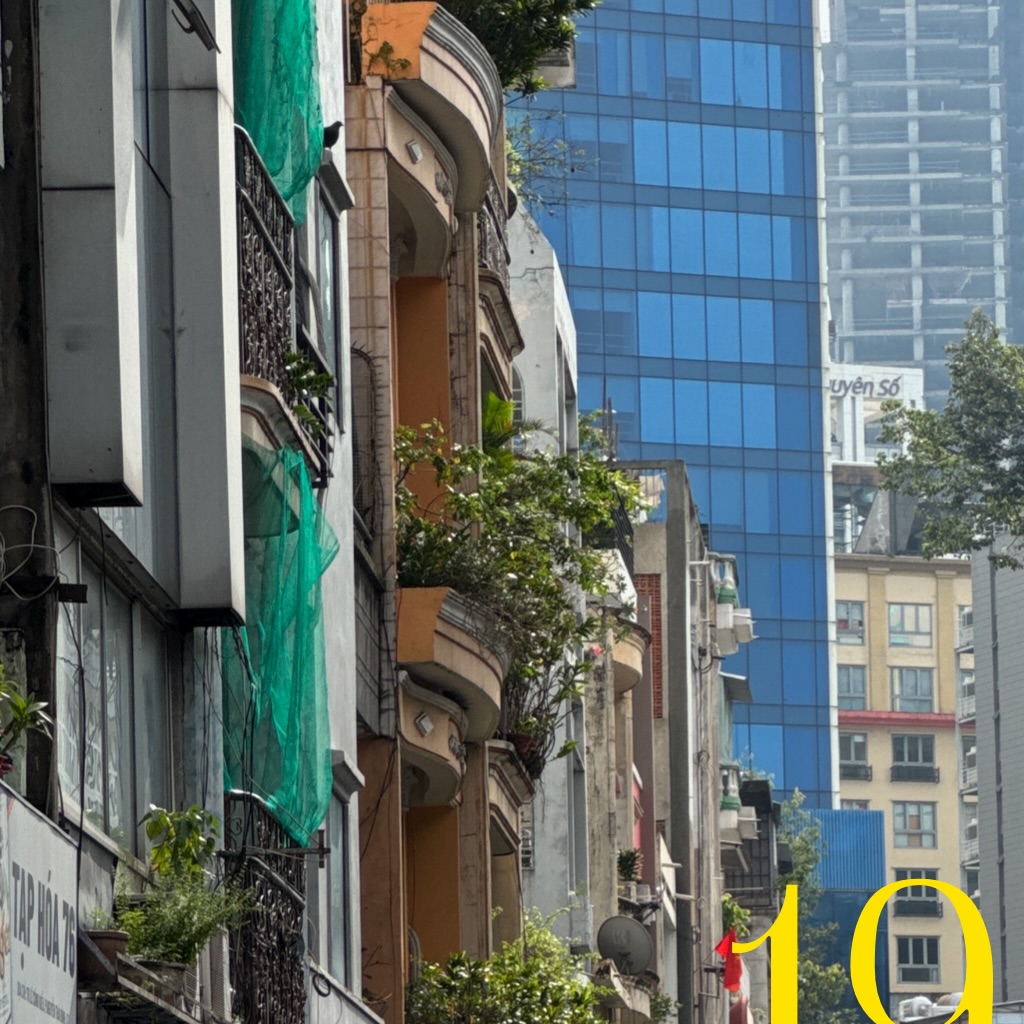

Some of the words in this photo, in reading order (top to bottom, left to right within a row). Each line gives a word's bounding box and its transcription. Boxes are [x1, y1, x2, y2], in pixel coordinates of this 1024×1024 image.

[830, 375, 875, 399] uyên
[878, 375, 902, 396] Số
[11, 860, 35, 970] TẠP
[37, 868, 60, 968] HÓA
[62, 899, 76, 979] 76
